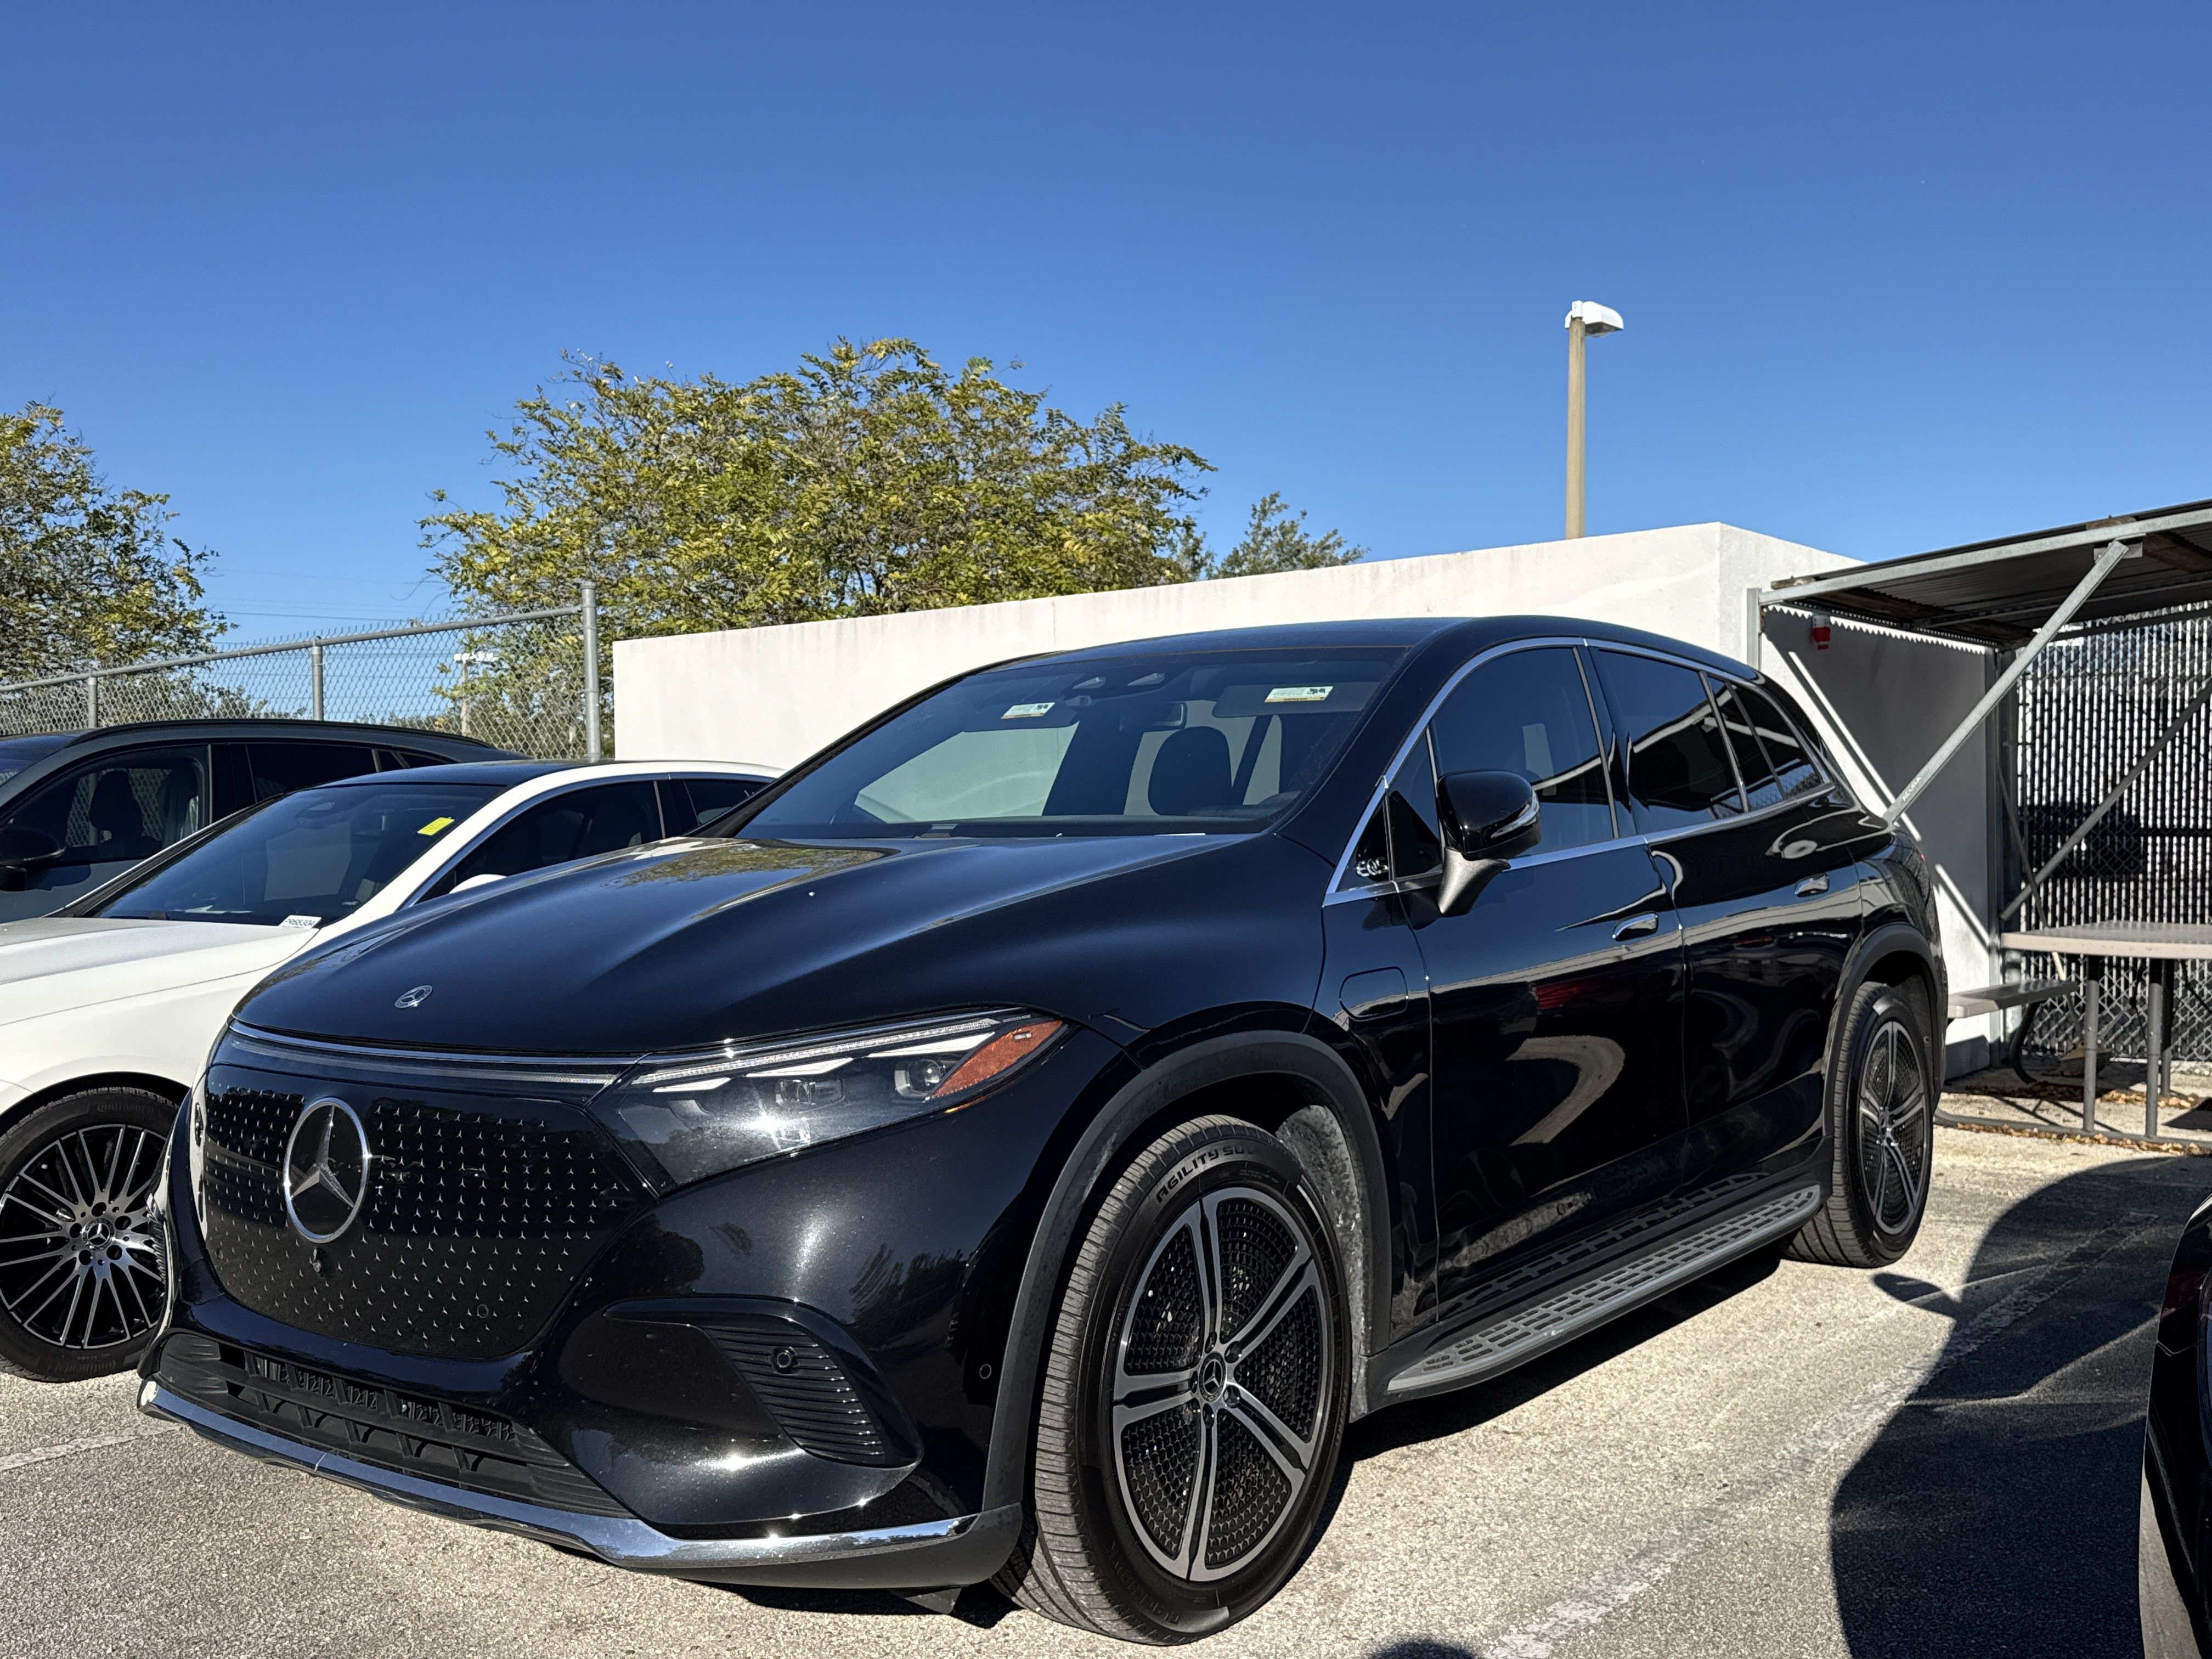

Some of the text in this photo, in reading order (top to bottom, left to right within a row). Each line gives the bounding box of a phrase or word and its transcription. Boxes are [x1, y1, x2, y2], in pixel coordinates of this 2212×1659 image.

[1903, 777, 1921, 802] ACURA
[1355, 856, 1389, 877] EQS
[1156, 1149, 1218, 1203] AGILITY
[1222, 1145, 1255, 1156] SUV
